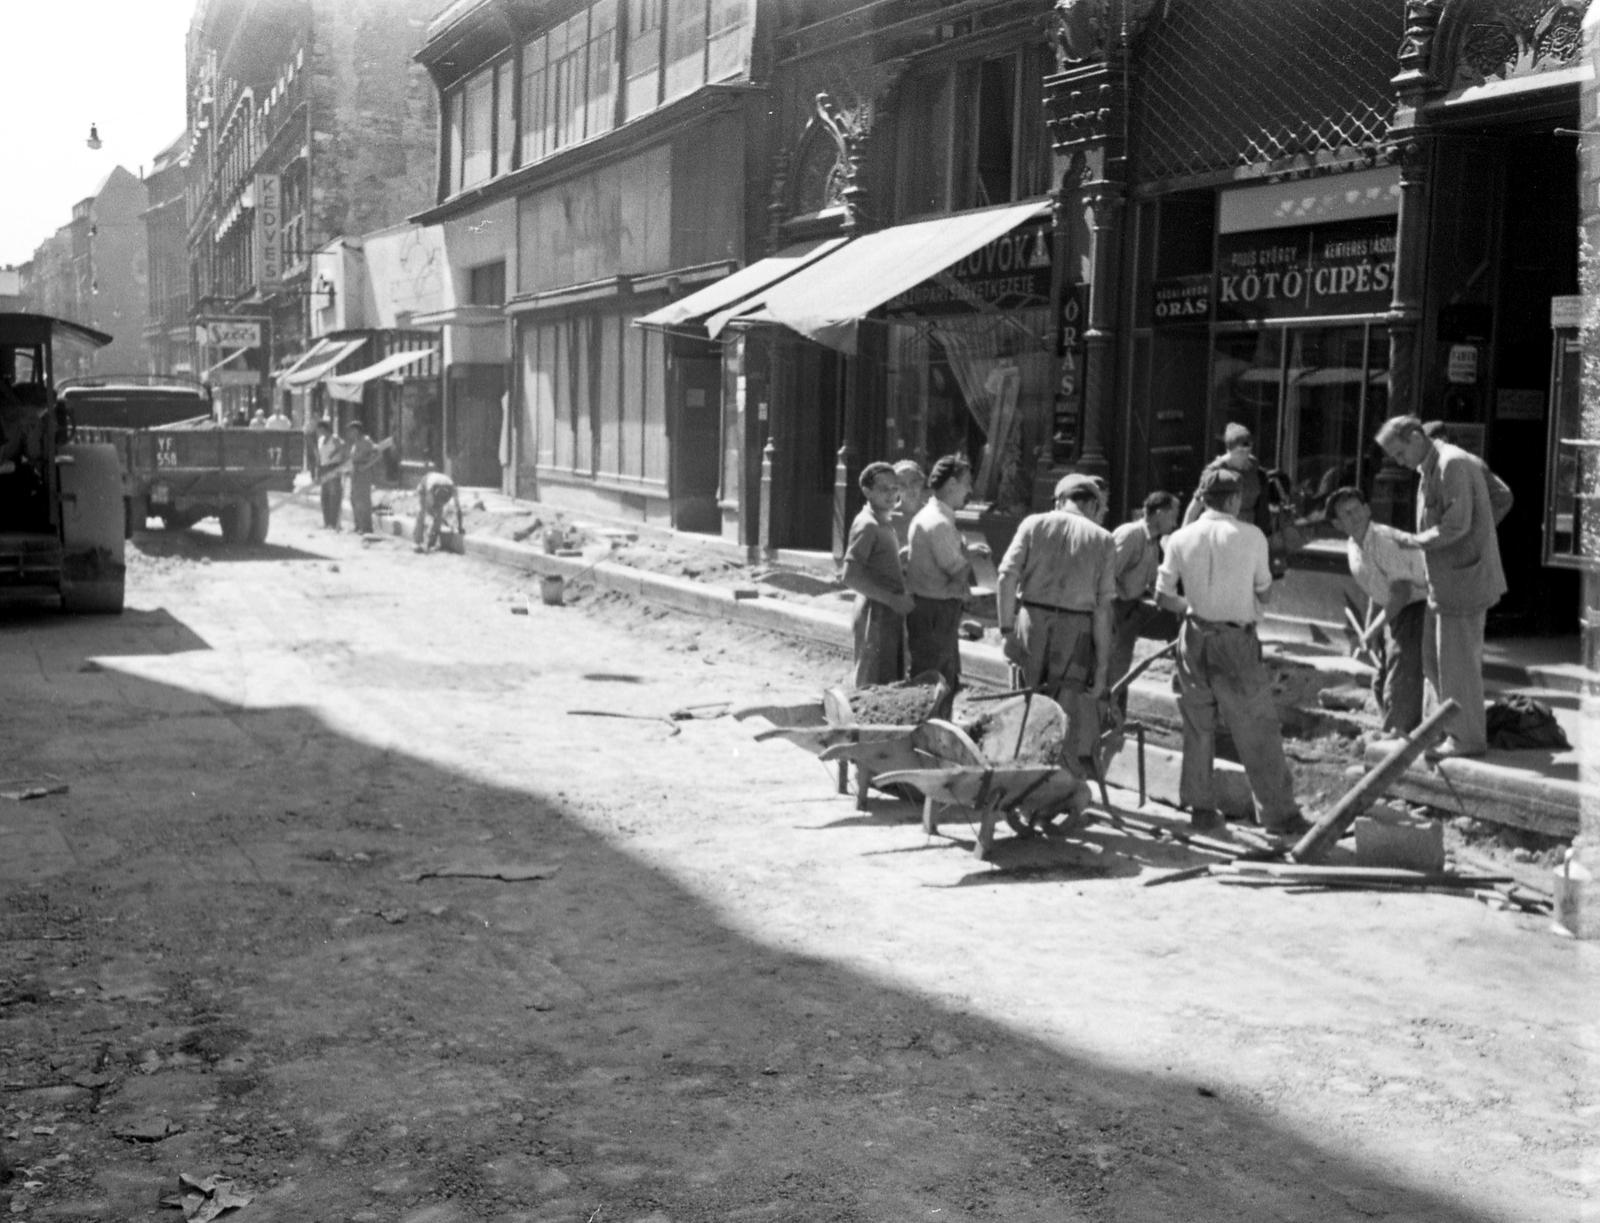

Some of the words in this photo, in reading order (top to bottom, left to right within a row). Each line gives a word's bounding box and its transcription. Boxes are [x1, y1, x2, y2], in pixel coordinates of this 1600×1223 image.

[262, 178, 277, 278] KEDVES
[1062, 297, 1079, 396] ÓRÁS
[1155, 297, 1208, 318] ÓRÁS
